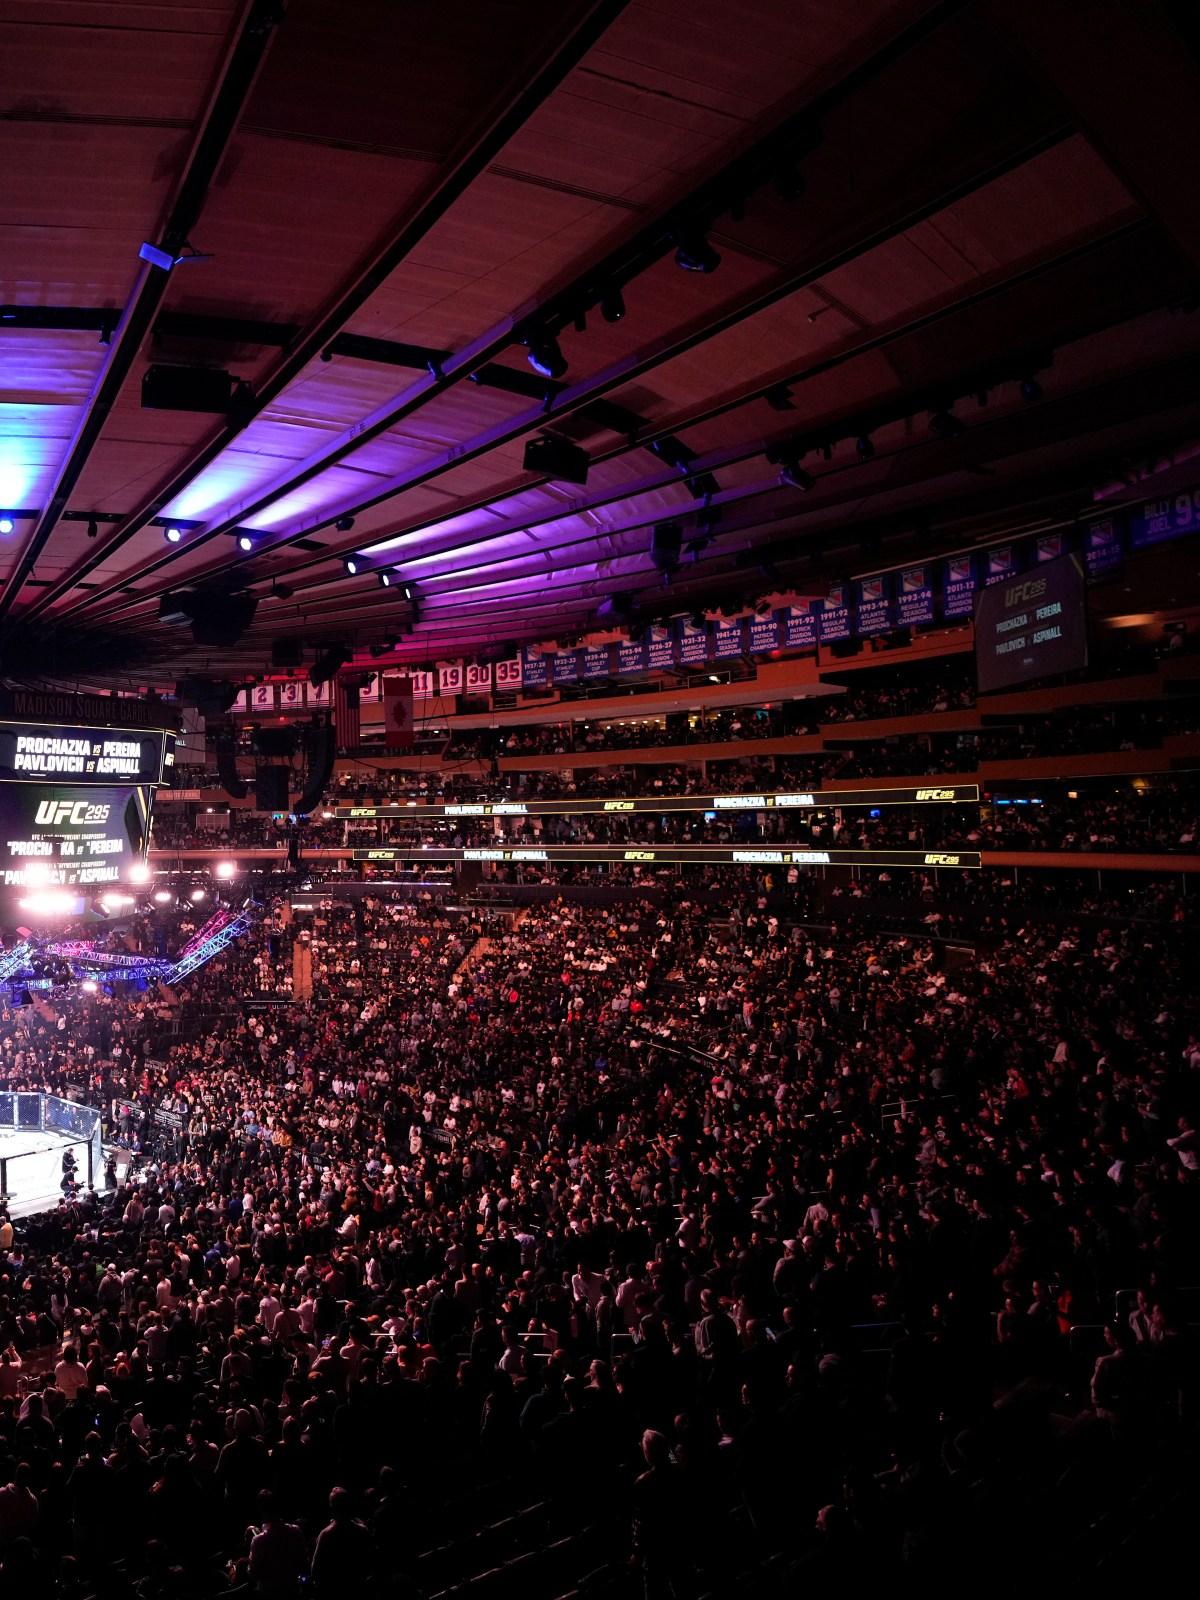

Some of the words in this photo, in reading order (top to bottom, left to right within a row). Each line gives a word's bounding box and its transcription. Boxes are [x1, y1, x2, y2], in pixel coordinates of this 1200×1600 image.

[1144, 500, 1170, 520] BILLY
[1147, 516, 1172, 534] JOEL
[946, 581, 975, 594] 2011-12
[898, 591, 932, 604] 1993-94
[1005, 580, 1033, 608] UFC
[859, 600, 889, 612] 1993-94
[944, 605, 974, 616] CHAMPION
[1036, 601, 1062, 620] PEREIRA
[820, 609, 848, 620] 1991-92
[898, 613, 933, 624] CHAMPIONS
[787, 616, 815, 627] 1991-92
[858, 621, 890, 632] CHAMPIONS
[750, 623, 777, 633] 1989-90
[824, 625, 844, 634] SEASON
[790, 632, 812, 640] DIVISION
[820, 630, 850, 640] CHAMPIONS
[995, 637, 1026, 655] PAVLOVICH
[1033, 625, 1062, 644] ASPINALL
[749, 643, 778, 651] CHAMPIONS
[786, 637, 816, 646] CHAMPIONS
[680, 653, 707, 663] CHAMPIONS
[715, 648, 742, 657] CHAMPIONS
[648, 659, 674, 668] CHAMPIONS
[470, 667, 490, 685] 30
[498, 662, 520, 681] 35
[414, 674, 428, 691] 11
[443, 669, 459, 688] 19
[258, 687, 267, 703] 2
[287, 685, 296, 701] 3
[13, 692, 74, 718] MADISON
[76, 695, 116, 720] SQUARE
[17, 736, 90, 756] PROCHAZKA
[103, 741, 141, 758] PEREIRA
[14, 754, 85, 773] PAVLOVICH
[96, 757, 140, 774] ASPINALL
[713, 796, 765, 808] PROCHAZKA
[775, 794, 815, 806] PEREIRA
[916, 790, 941, 801] UFC
[492, 804, 528, 814] ASPINALL
[603, 802, 624, 810] UFC
[35, 800, 89, 825] UFC
[85, 804, 111, 820] 295
[10, 841, 75, 856] PROCHKA
[89, 838, 124, 854] PEREIRA
[368, 851, 386, 859] UFC
[463, 850, 504, 860] PAVLOVICH
[512, 850, 548, 860] ASPINALL
[625, 851, 645, 860] UFC
[732, 851, 783, 862] PROCHAZKA
[792, 852, 830, 863] PEREIRA
[924, 854, 948, 864] UFC
[79, 866, 120, 883] ASPINALL
